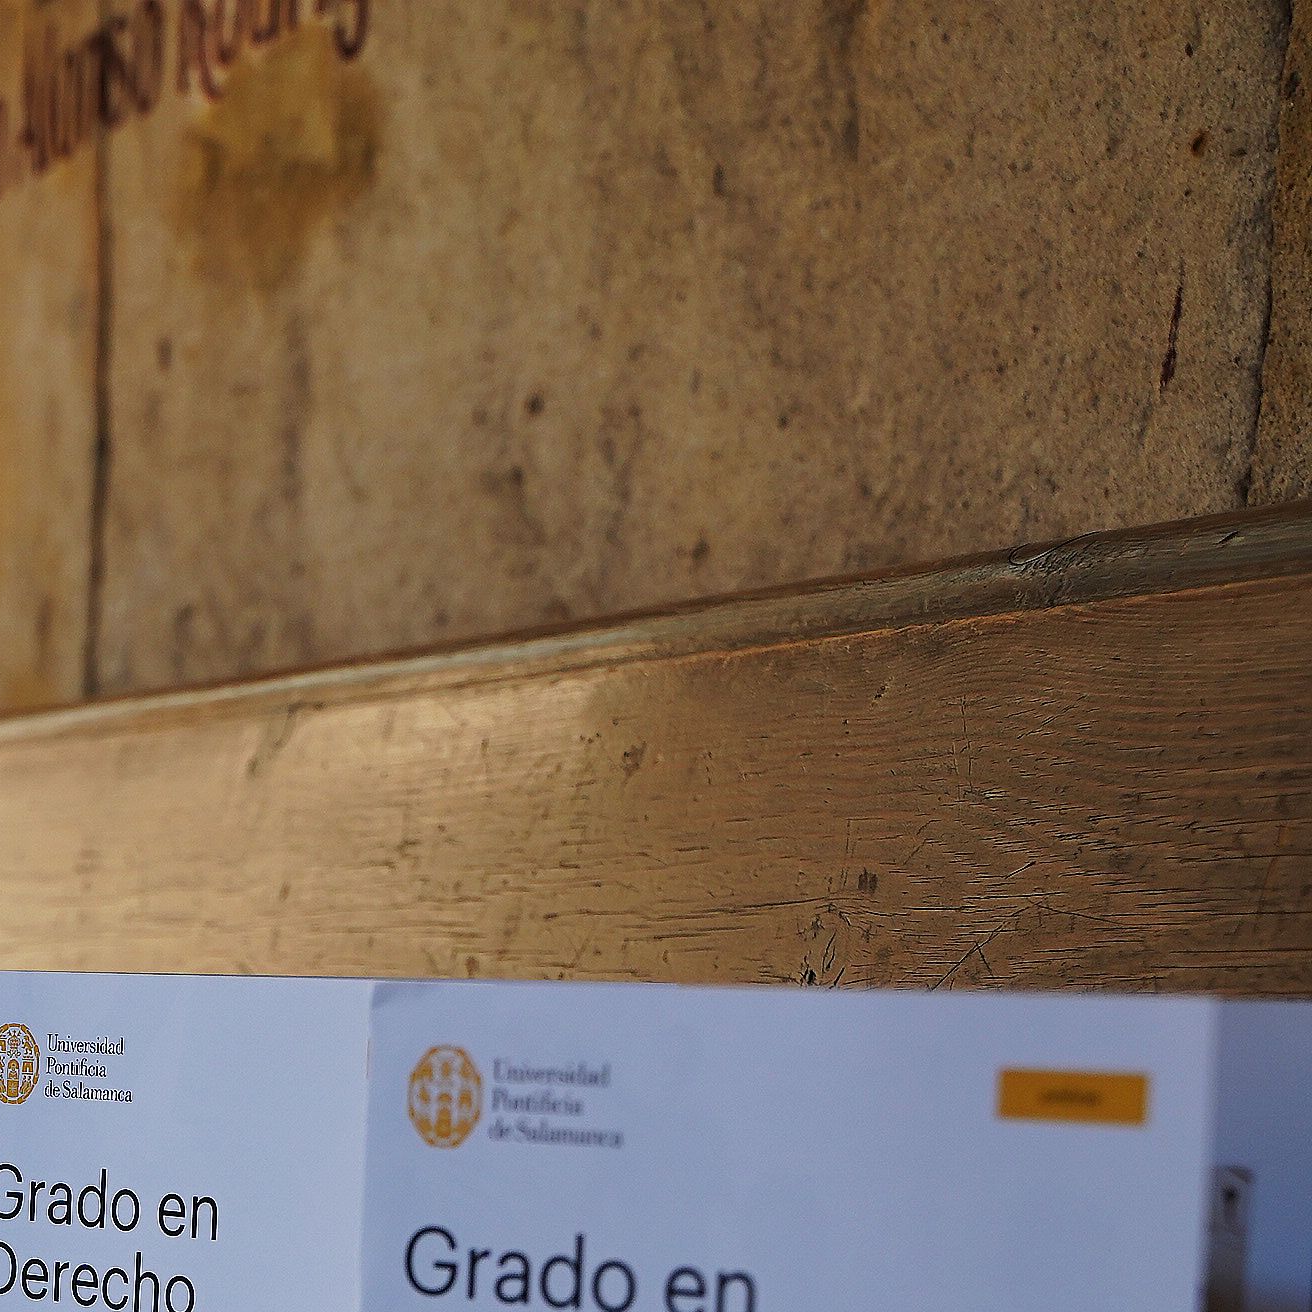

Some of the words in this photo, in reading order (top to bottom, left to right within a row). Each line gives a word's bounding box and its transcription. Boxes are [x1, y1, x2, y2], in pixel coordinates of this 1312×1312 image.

[47, 1033, 124, 1055] Universidad
[46, 1056, 107, 1078] Pontificia
[44, 1079, 60, 1098] de
[62, 1080, 133, 1103] Salamanca
[157, 1193, 218, 1240] en
